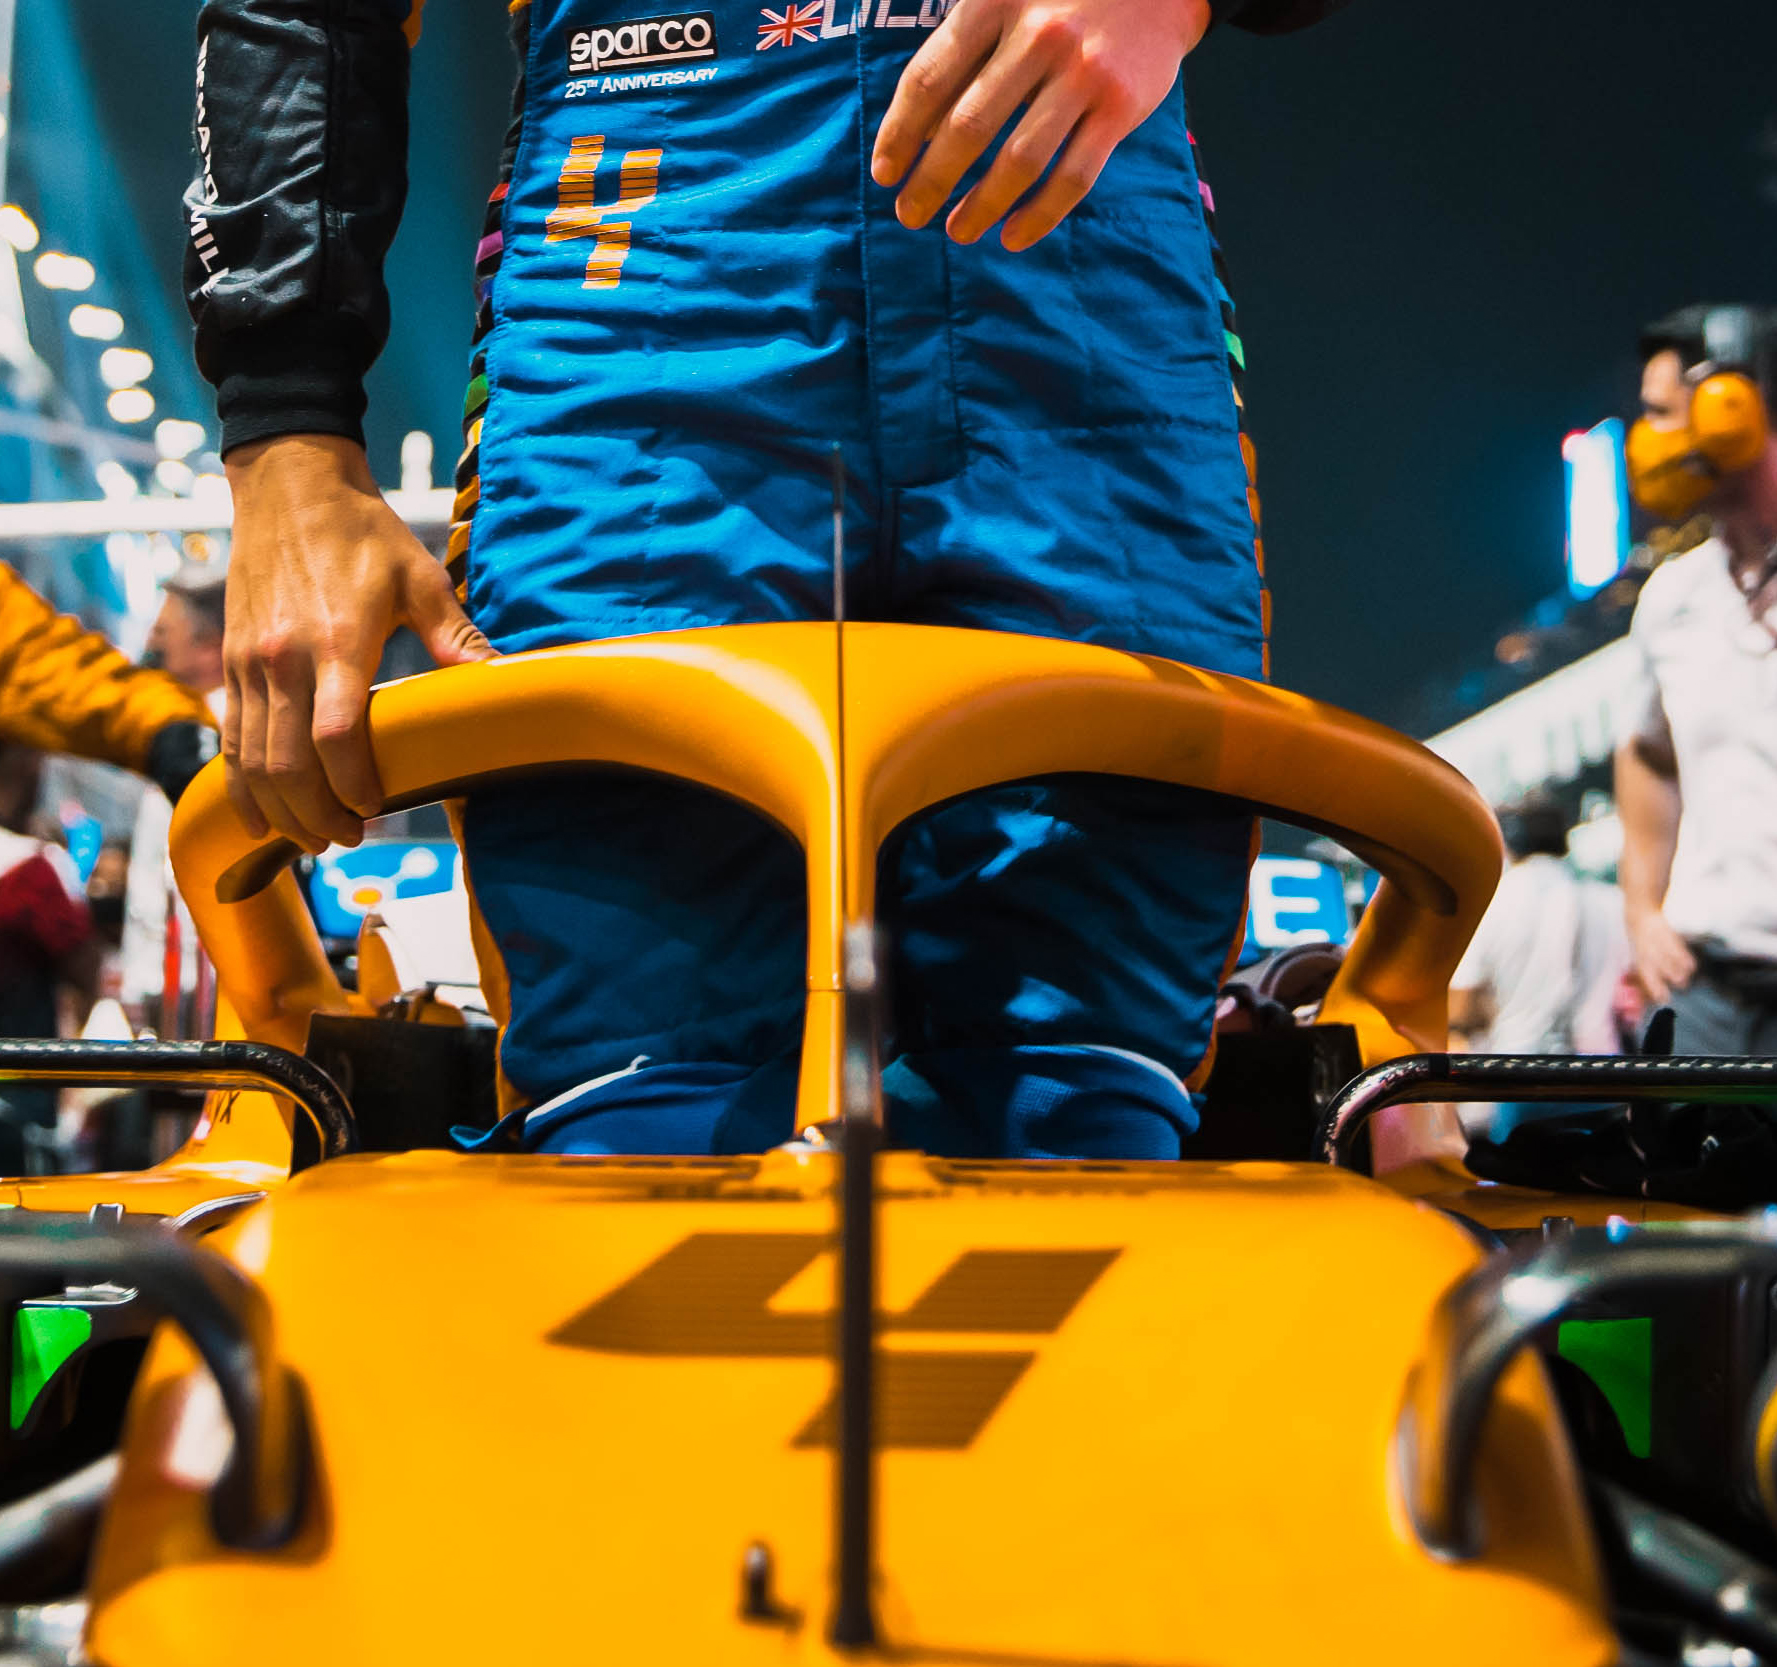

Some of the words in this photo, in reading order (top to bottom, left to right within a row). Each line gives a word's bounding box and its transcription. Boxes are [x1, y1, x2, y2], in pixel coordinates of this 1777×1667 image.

[569, 15, 714, 71] sparco
[600, 66, 719, 93] ANNIVERSARY
[544, 133, 664, 290] 4
[543, 1230, 1126, 1450] 4
